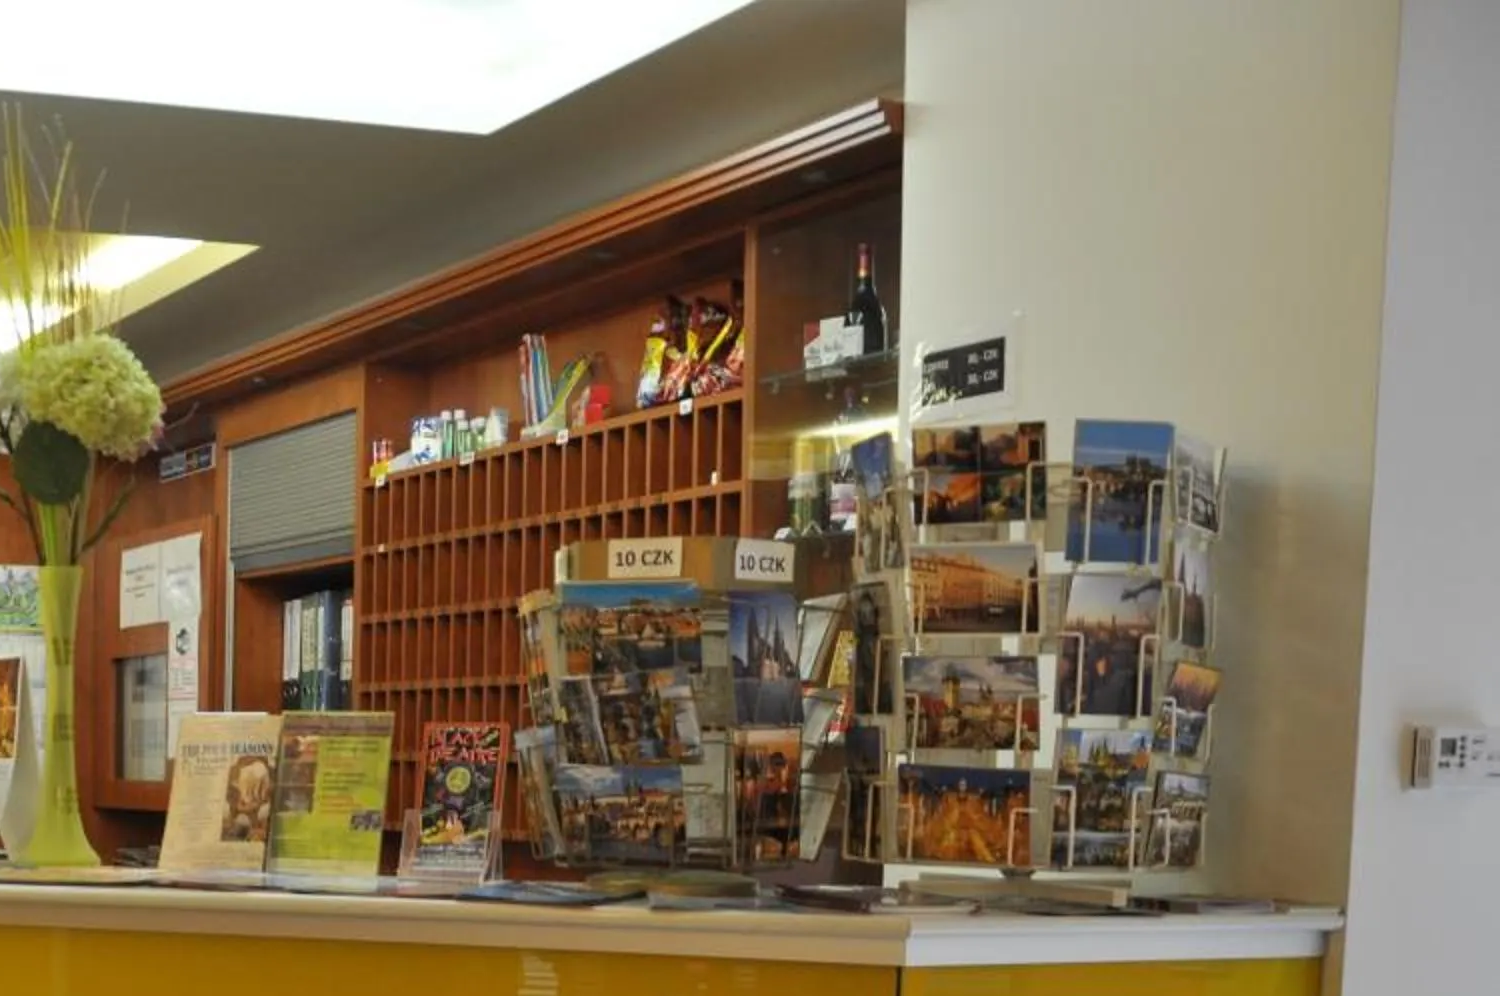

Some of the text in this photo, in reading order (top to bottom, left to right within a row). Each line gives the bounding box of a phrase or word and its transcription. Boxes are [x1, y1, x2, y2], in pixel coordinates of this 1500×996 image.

[615, 550, 673, 567] 10 CZK
[740, 555, 785, 572] 10 CZK
